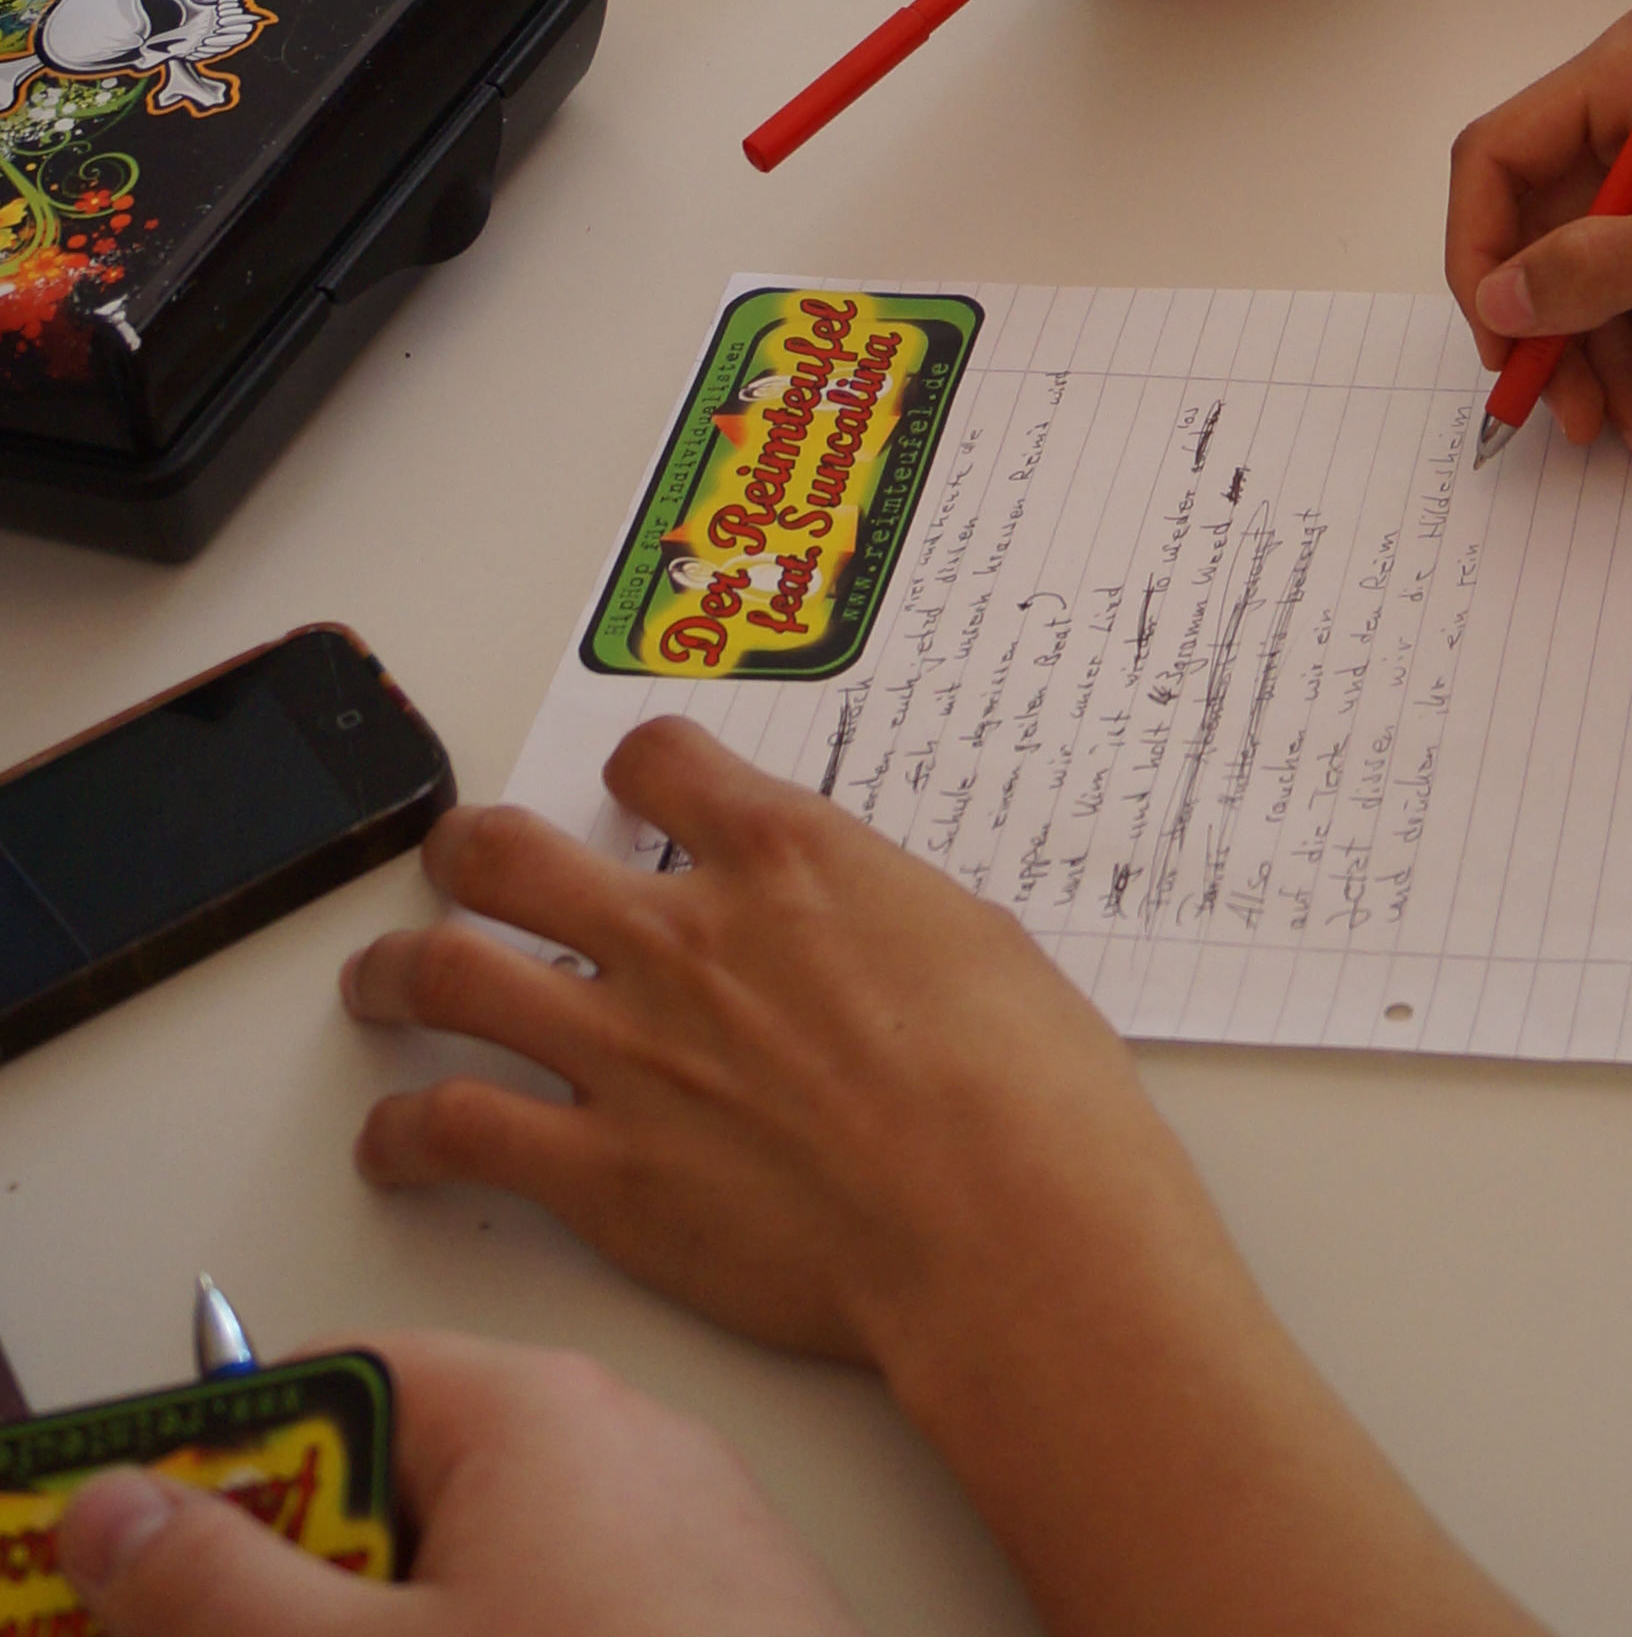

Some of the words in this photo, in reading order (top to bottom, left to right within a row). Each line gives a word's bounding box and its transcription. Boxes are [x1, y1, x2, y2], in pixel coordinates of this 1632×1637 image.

[778, 331, 903, 539] Suncalina
[604, 559, 657, 637] HipHop
[642, 516, 669, 552] für
[661, 341, 745, 505] Individualisten
[660, 568, 751, 668] Der
[709, 297, 858, 556] Reimteufel
[843, 361, 951, 622] www.reimteufel.de
[928, 463, 973, 528] heute
[747, 545, 822, 634] feat.
[1357, 528, 1401, 590] Reim
[1032, 616, 1073, 667] Beat
[1349, 723, 1399, 812] dissen
[1397, 562, 1437, 603] die
[1417, 405, 1472, 539] Hildesheim
[1333, 657, 1371, 714] und
[1225, 859, 1273, 930] Also
[1261, 727, 1307, 823] rauchen
[1299, 662, 1324, 702] wir
[1312, 608, 1334, 645] ein
[926, 771, 978, 854] Schule
[1013, 821, 1052, 903] rappen
[1048, 743, 1074, 791] wir
[1121, 788, 1152, 842] und
[1290, 818, 1332, 864] die
[1053, 848, 1090, 906] und
[1277, 886, 1312, 930] auf
[1374, 864, 1414, 923] und
